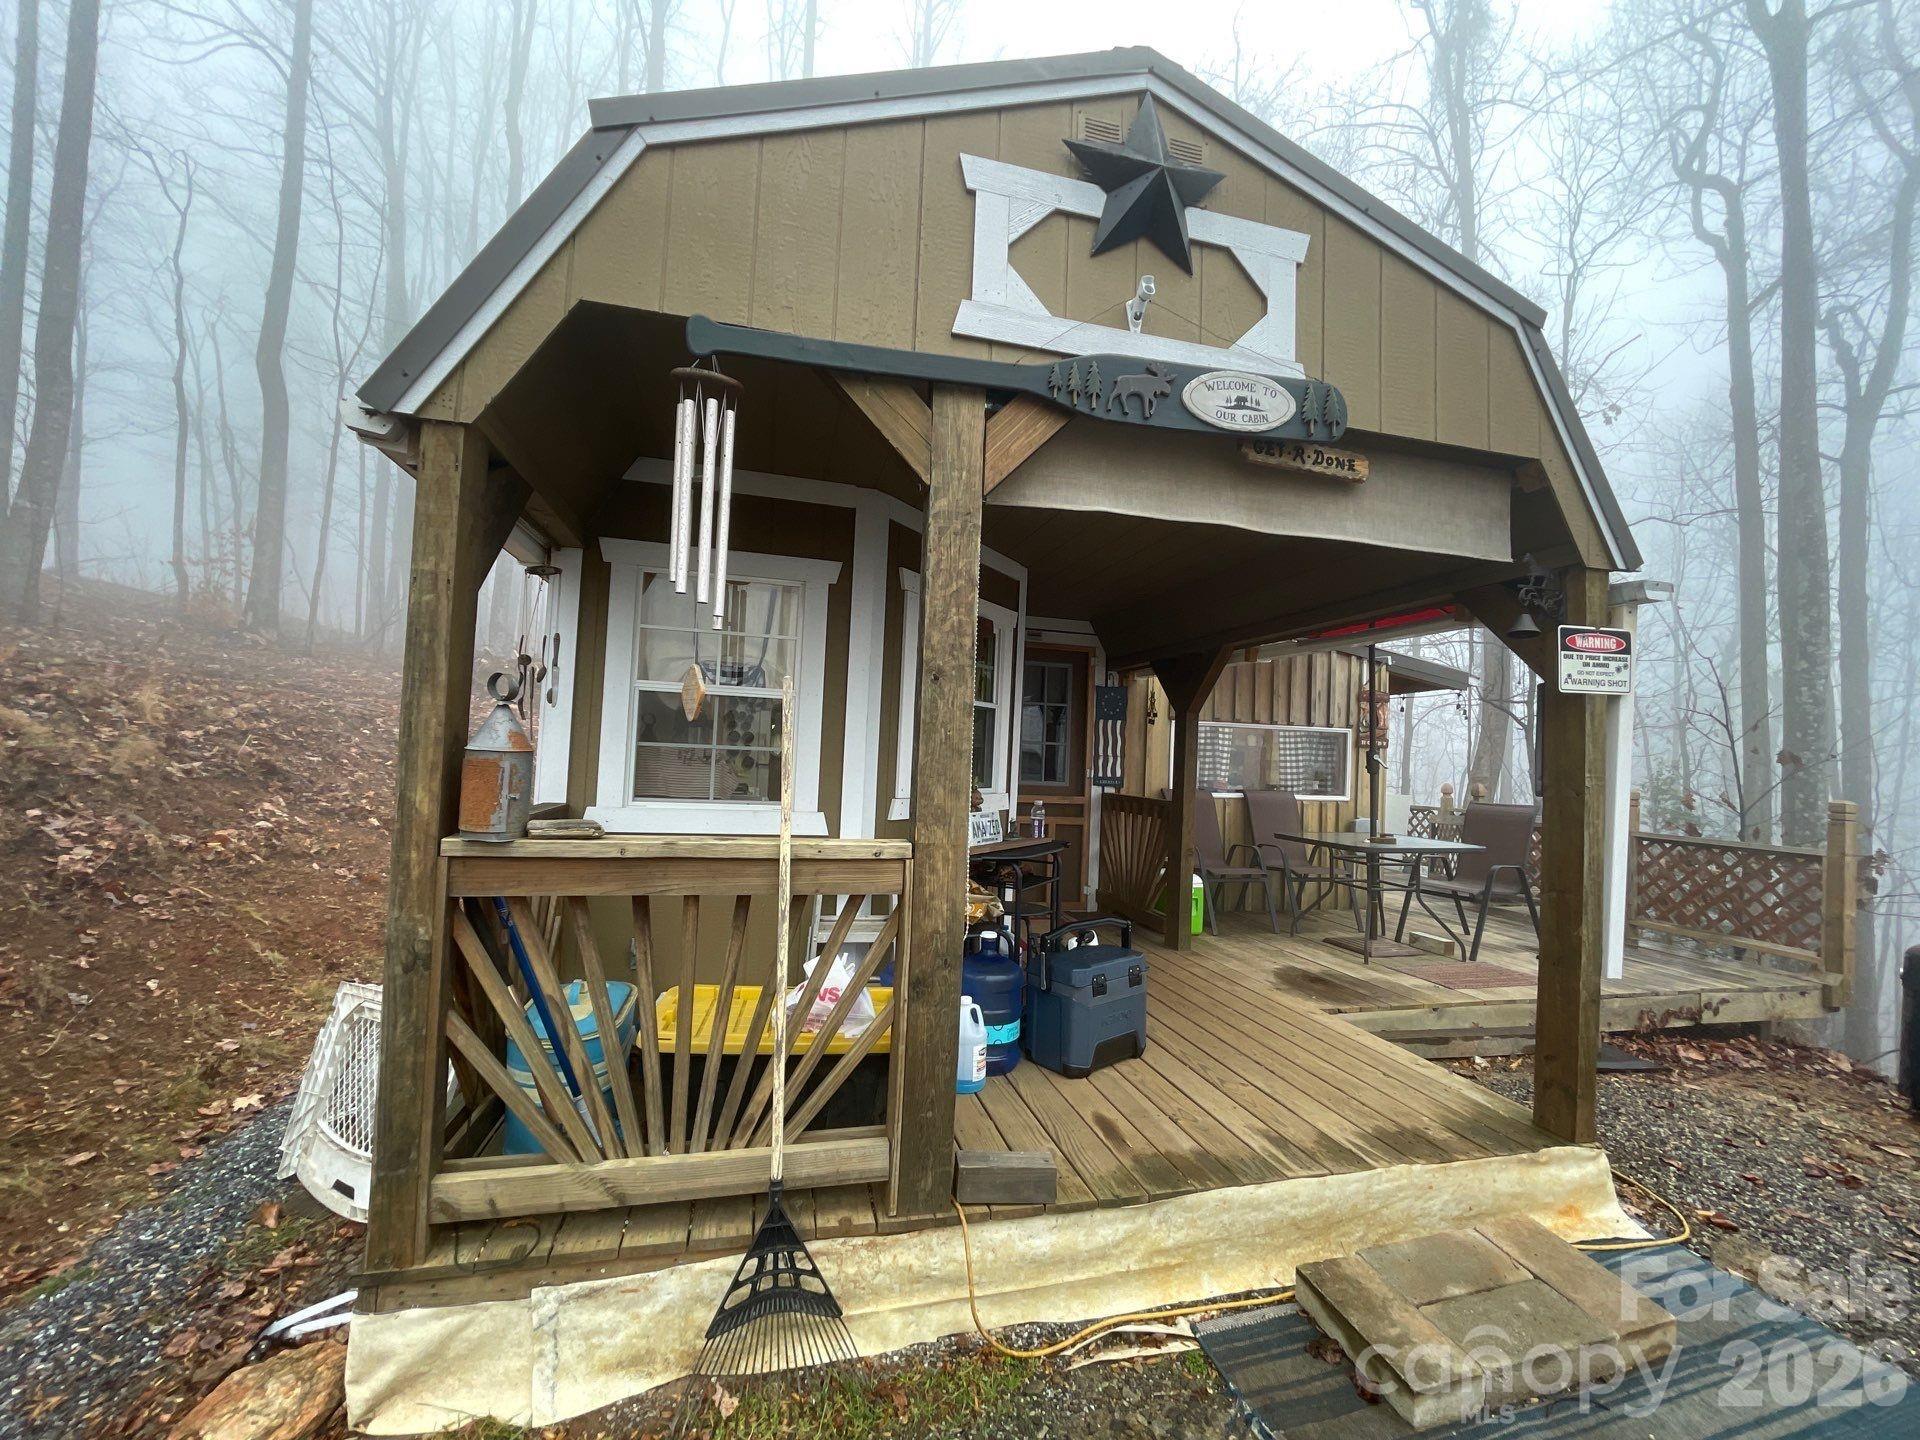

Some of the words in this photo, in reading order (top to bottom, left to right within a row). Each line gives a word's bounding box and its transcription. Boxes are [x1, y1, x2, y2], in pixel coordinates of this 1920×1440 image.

[1204, 380, 1257, 393] WELCOME
[1263, 386, 1278, 399] TO
[1215, 409, 1237, 422] OUR
[1241, 413, 1270, 424] CABIN
[1574, 634, 1618, 650] WARNING
[1576, 653, 1584, 661] TO
[1585, 654, 1601, 662] PRICE
[1602, 655, 1629, 663] INCREASE
[1563, 677, 1570, 685] A
[1571, 678, 1606, 687] WARNING
[1607, 680, 1628, 688] SHOT
